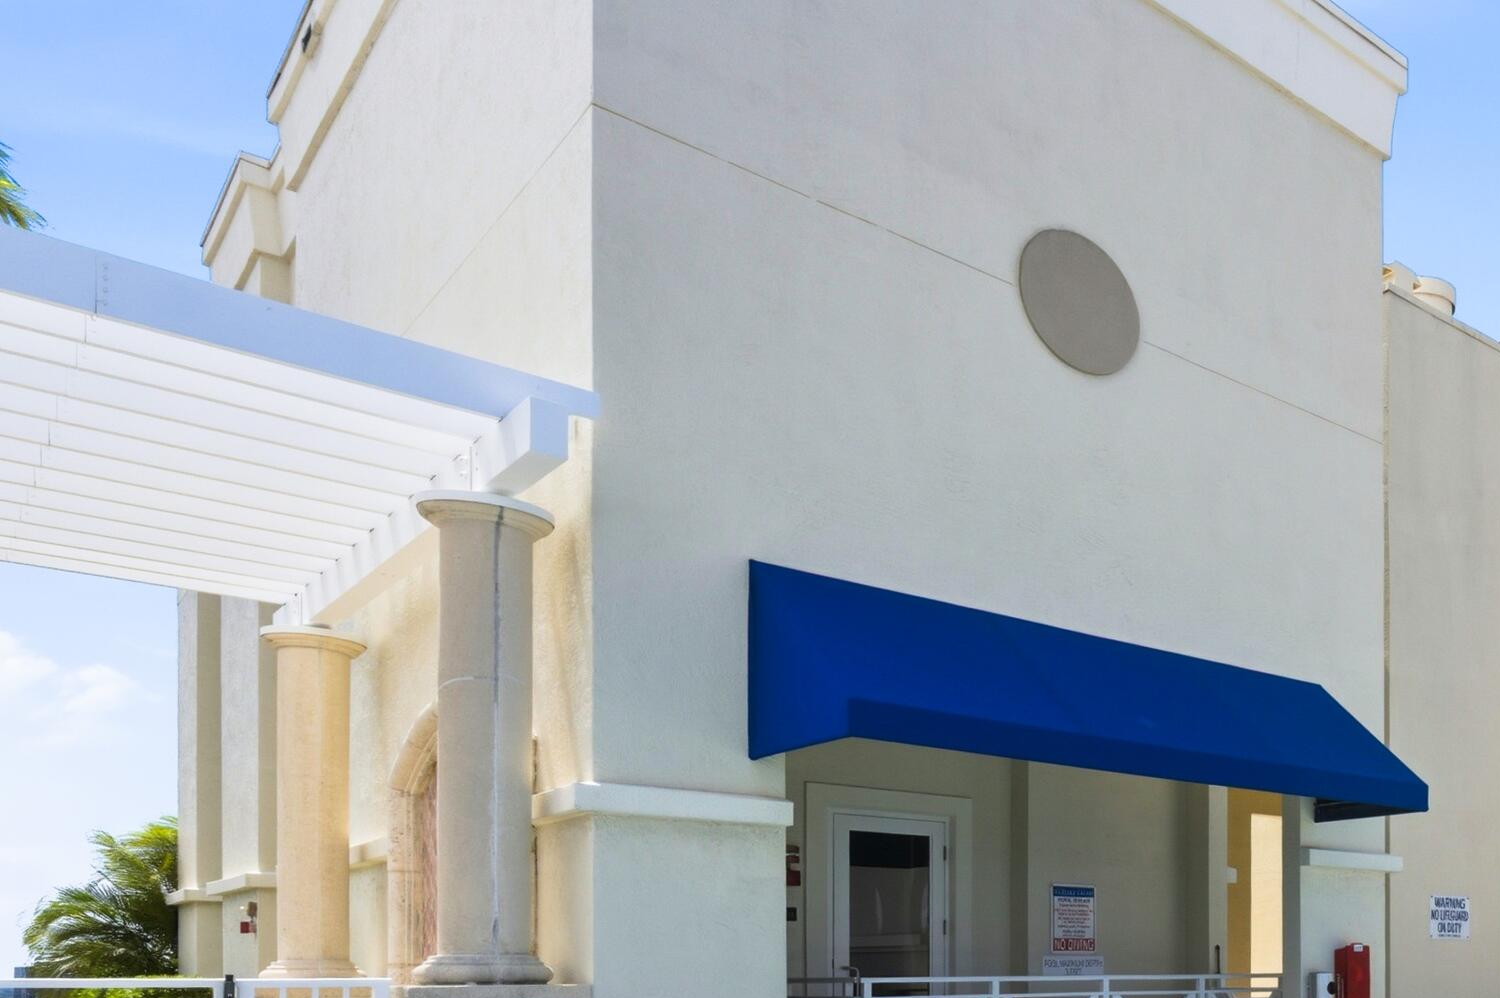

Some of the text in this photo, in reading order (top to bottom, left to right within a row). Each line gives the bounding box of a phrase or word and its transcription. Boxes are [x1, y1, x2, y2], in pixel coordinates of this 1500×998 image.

[1434, 896, 1466, 909] WARNING
[1431, 910, 1439, 920] NO
[1437, 922, 1461, 933] ON DUTY
[1054, 939, 1094, 951] NO DIVING
